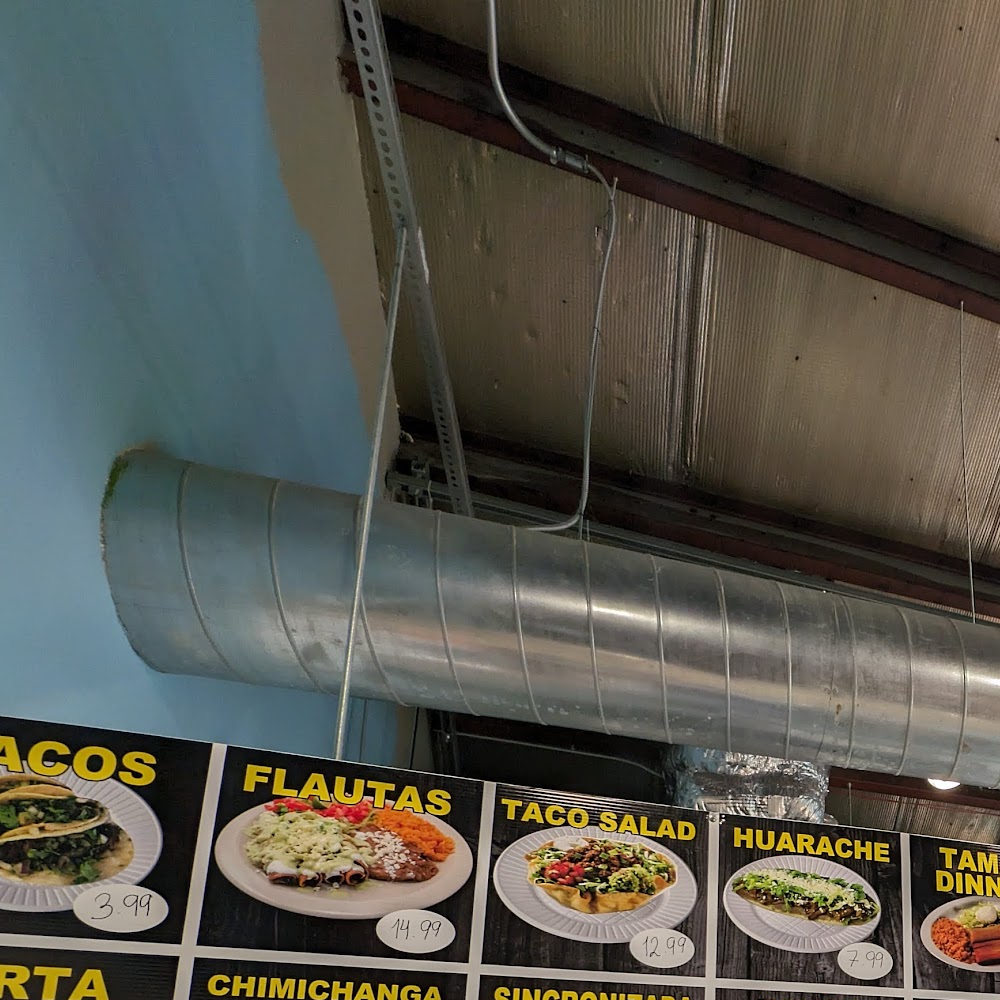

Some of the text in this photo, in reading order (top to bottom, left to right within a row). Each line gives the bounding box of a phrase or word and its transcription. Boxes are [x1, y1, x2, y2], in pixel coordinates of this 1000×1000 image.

[243, 764, 452, 816] FLAUTAS
[501, 798, 696, 841] TACO SALAD
[734, 827, 890, 863] HUARACHE
[91, 893, 151, 921] 3.99
[391, 918, 442, 940] 14.99
[643, 935, 687, 957] 12.99
[849, 949, 884, 968] 7.99
